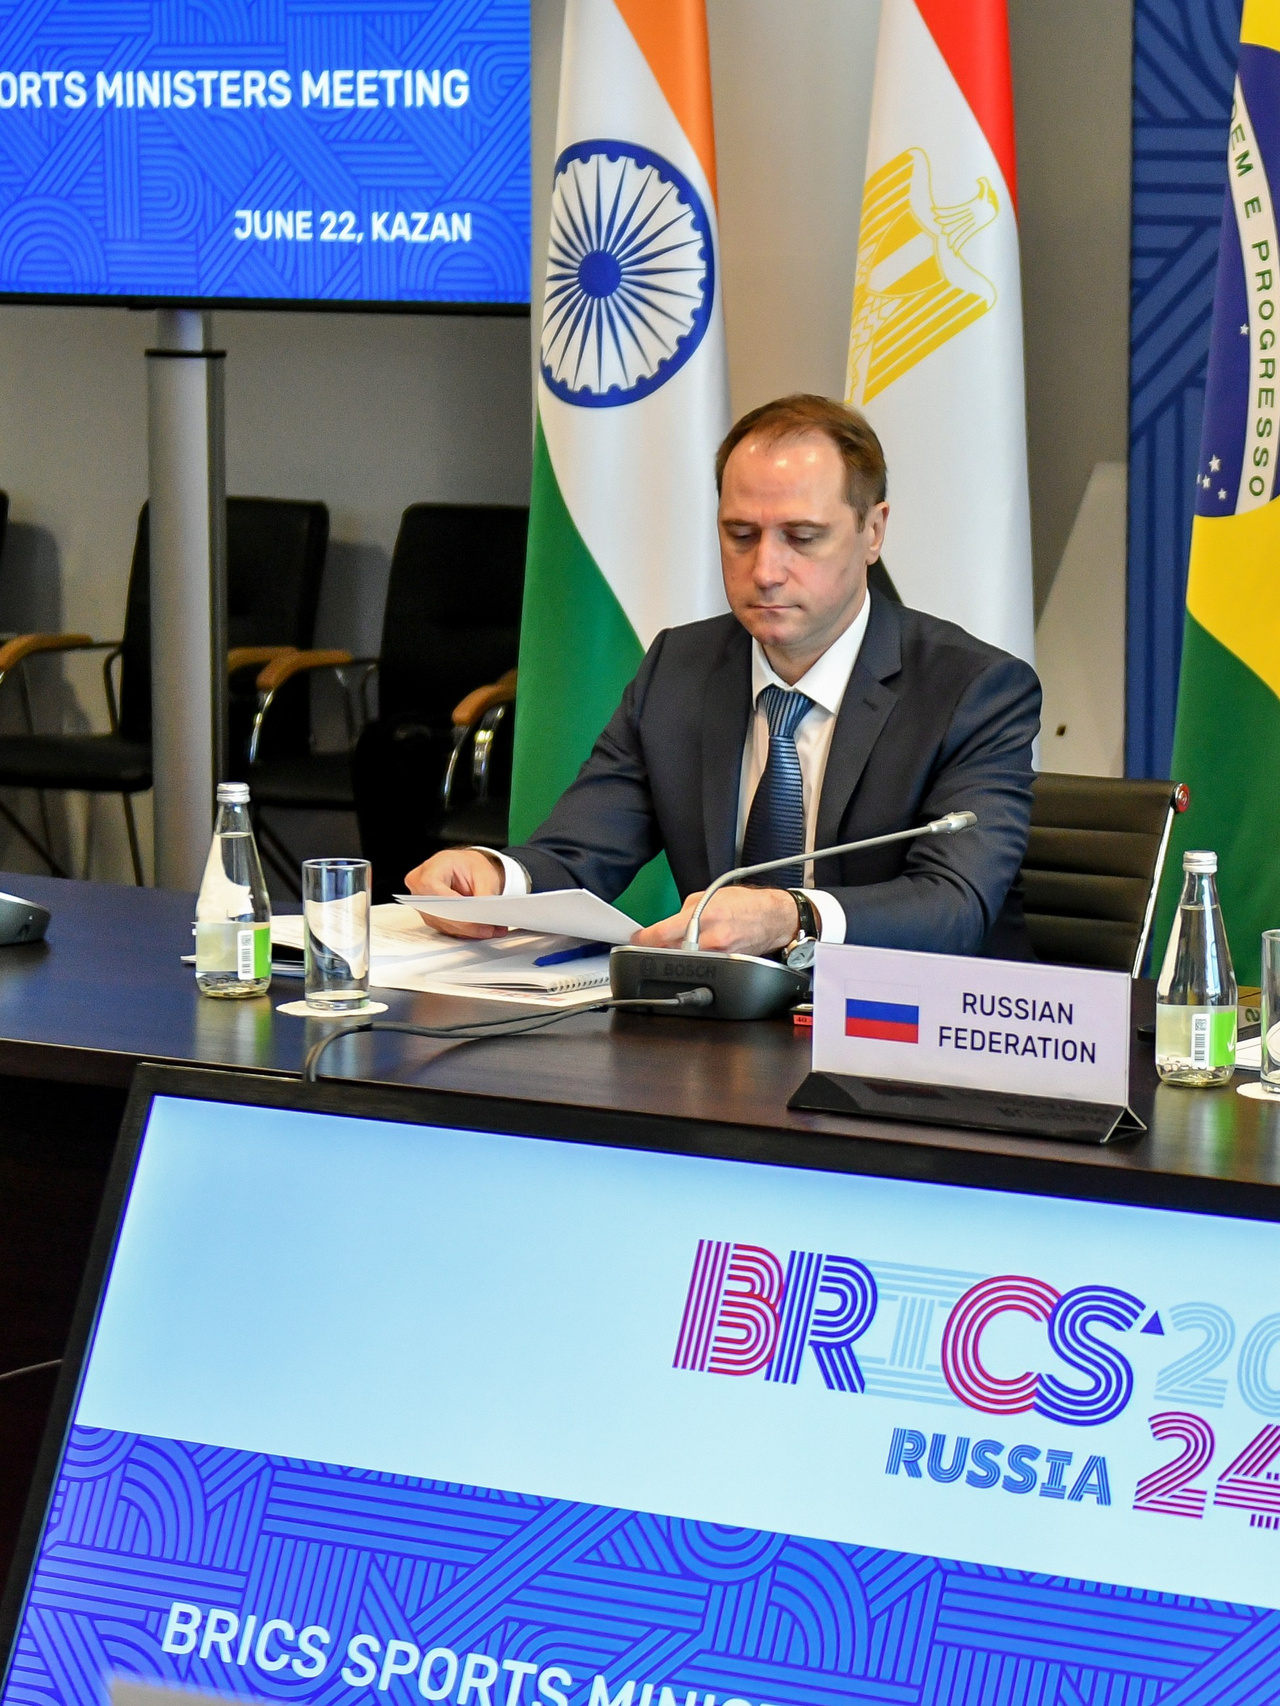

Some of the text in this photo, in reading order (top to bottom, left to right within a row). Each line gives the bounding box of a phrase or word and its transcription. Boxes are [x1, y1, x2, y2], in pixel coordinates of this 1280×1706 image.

[0, 68, 470, 109] ORTS MINISTERS MEETING
[234, 209, 471, 244] JUNE 22, KAZAN
[1244, 196, 1262, 219] E
[1246, 238, 1275, 497] PROGRESSO
[663, 963, 716, 978] BOSCH
[962, 992, 1073, 1025] RUSSIAN
[938, 1026, 1096, 1064] FEDERATION
[672, 1238, 1145, 1428] BRICS
[885, 1427, 1112, 1506] RUSSIA
[161, 1601, 333, 1679] BRICS
[341, 1634, 573, 1706] SPORTS
